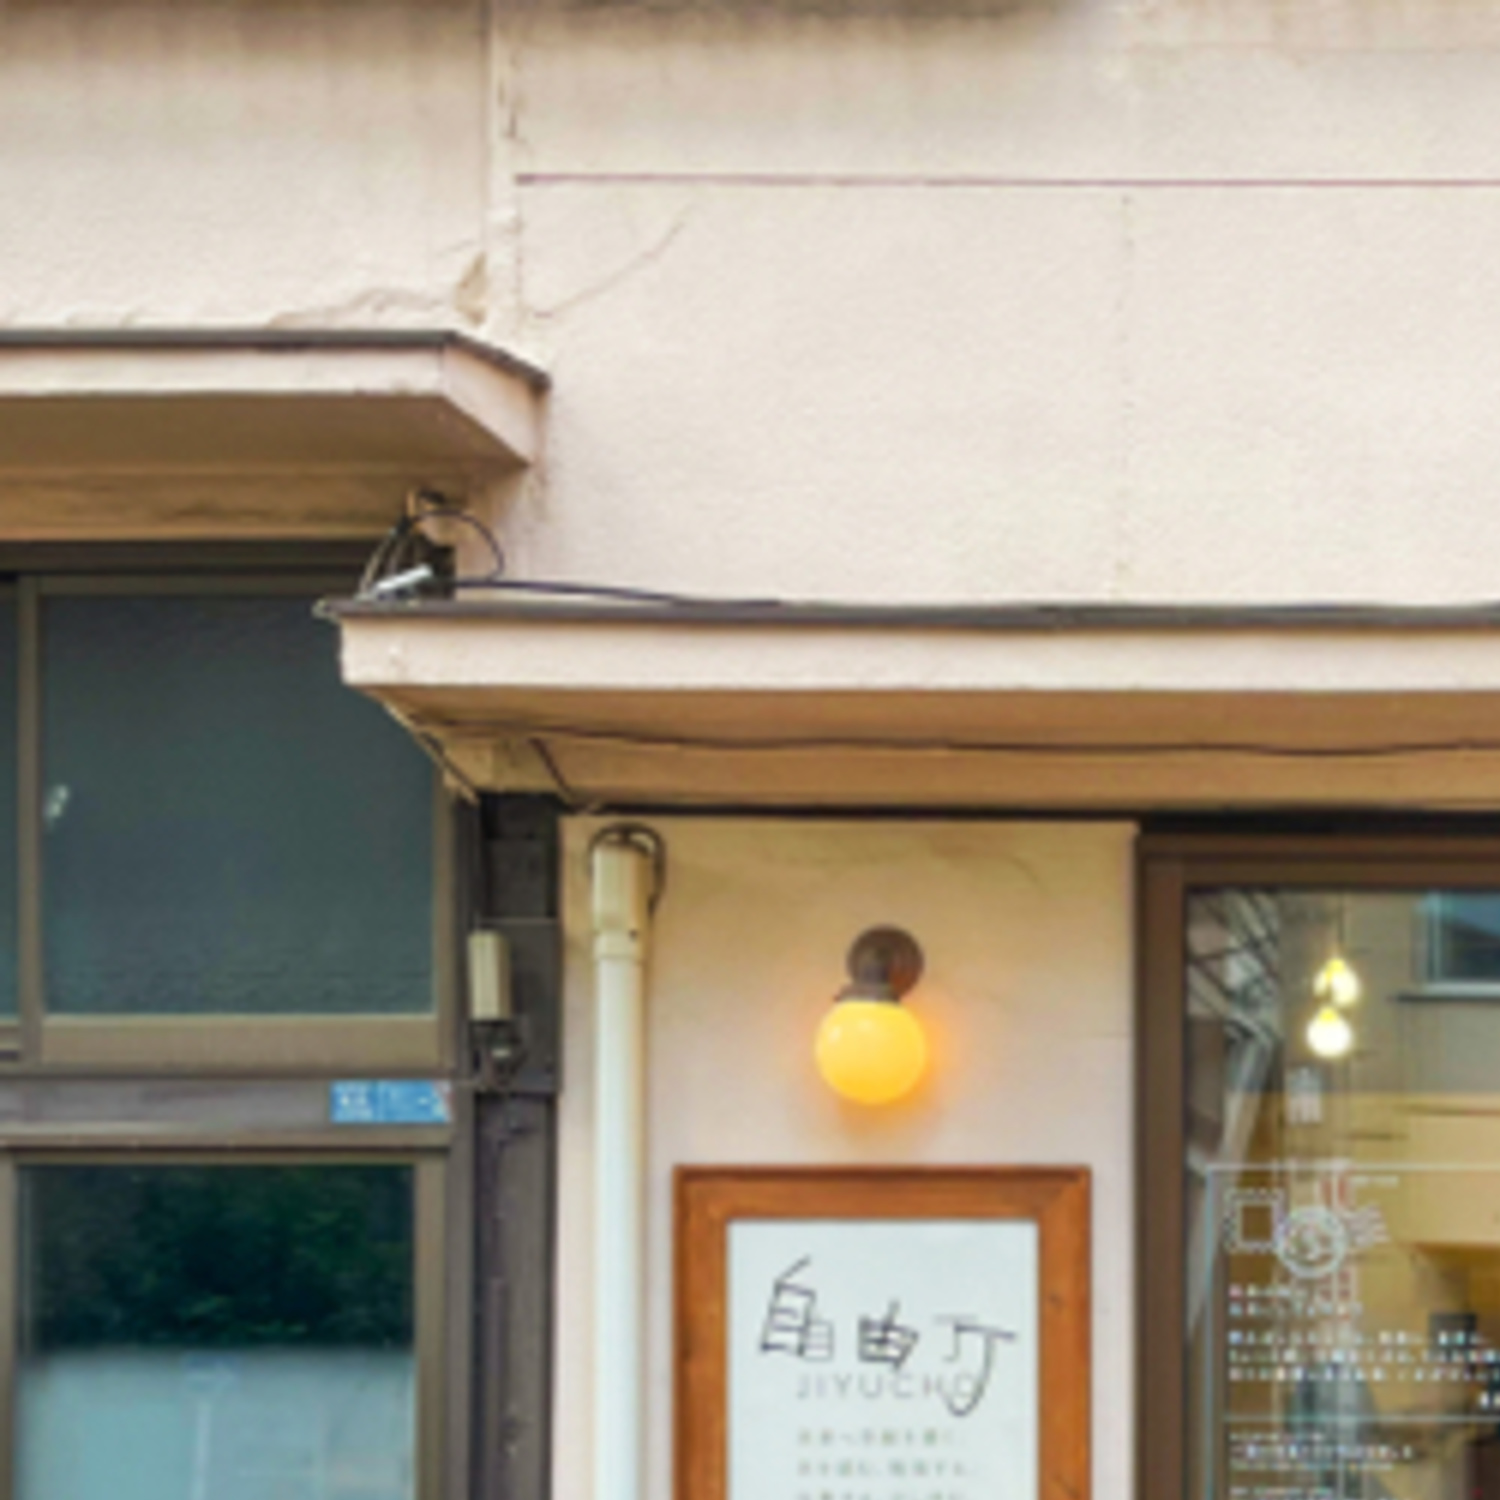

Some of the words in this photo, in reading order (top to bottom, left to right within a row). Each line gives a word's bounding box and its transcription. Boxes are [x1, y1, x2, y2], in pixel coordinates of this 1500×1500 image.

[759, 1254, 1017, 1417] 自由丁
[797, 1373, 977, 1400] JIYUCHO
